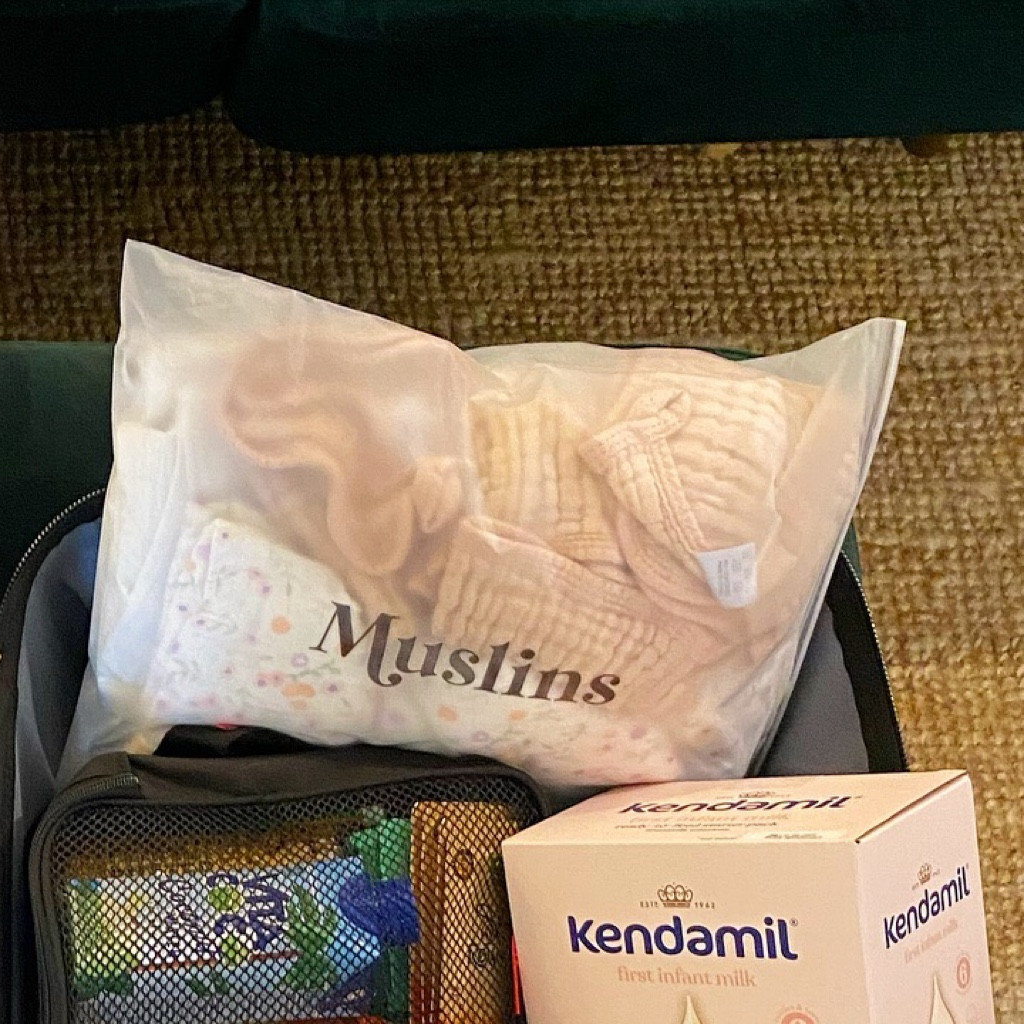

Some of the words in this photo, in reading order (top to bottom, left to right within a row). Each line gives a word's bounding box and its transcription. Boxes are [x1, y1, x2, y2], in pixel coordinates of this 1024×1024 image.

[309, 600, 622, 706] Muslins
[616, 966, 652, 984] first
[656, 966, 712, 986] infant
[715, 968, 759, 989] milk
